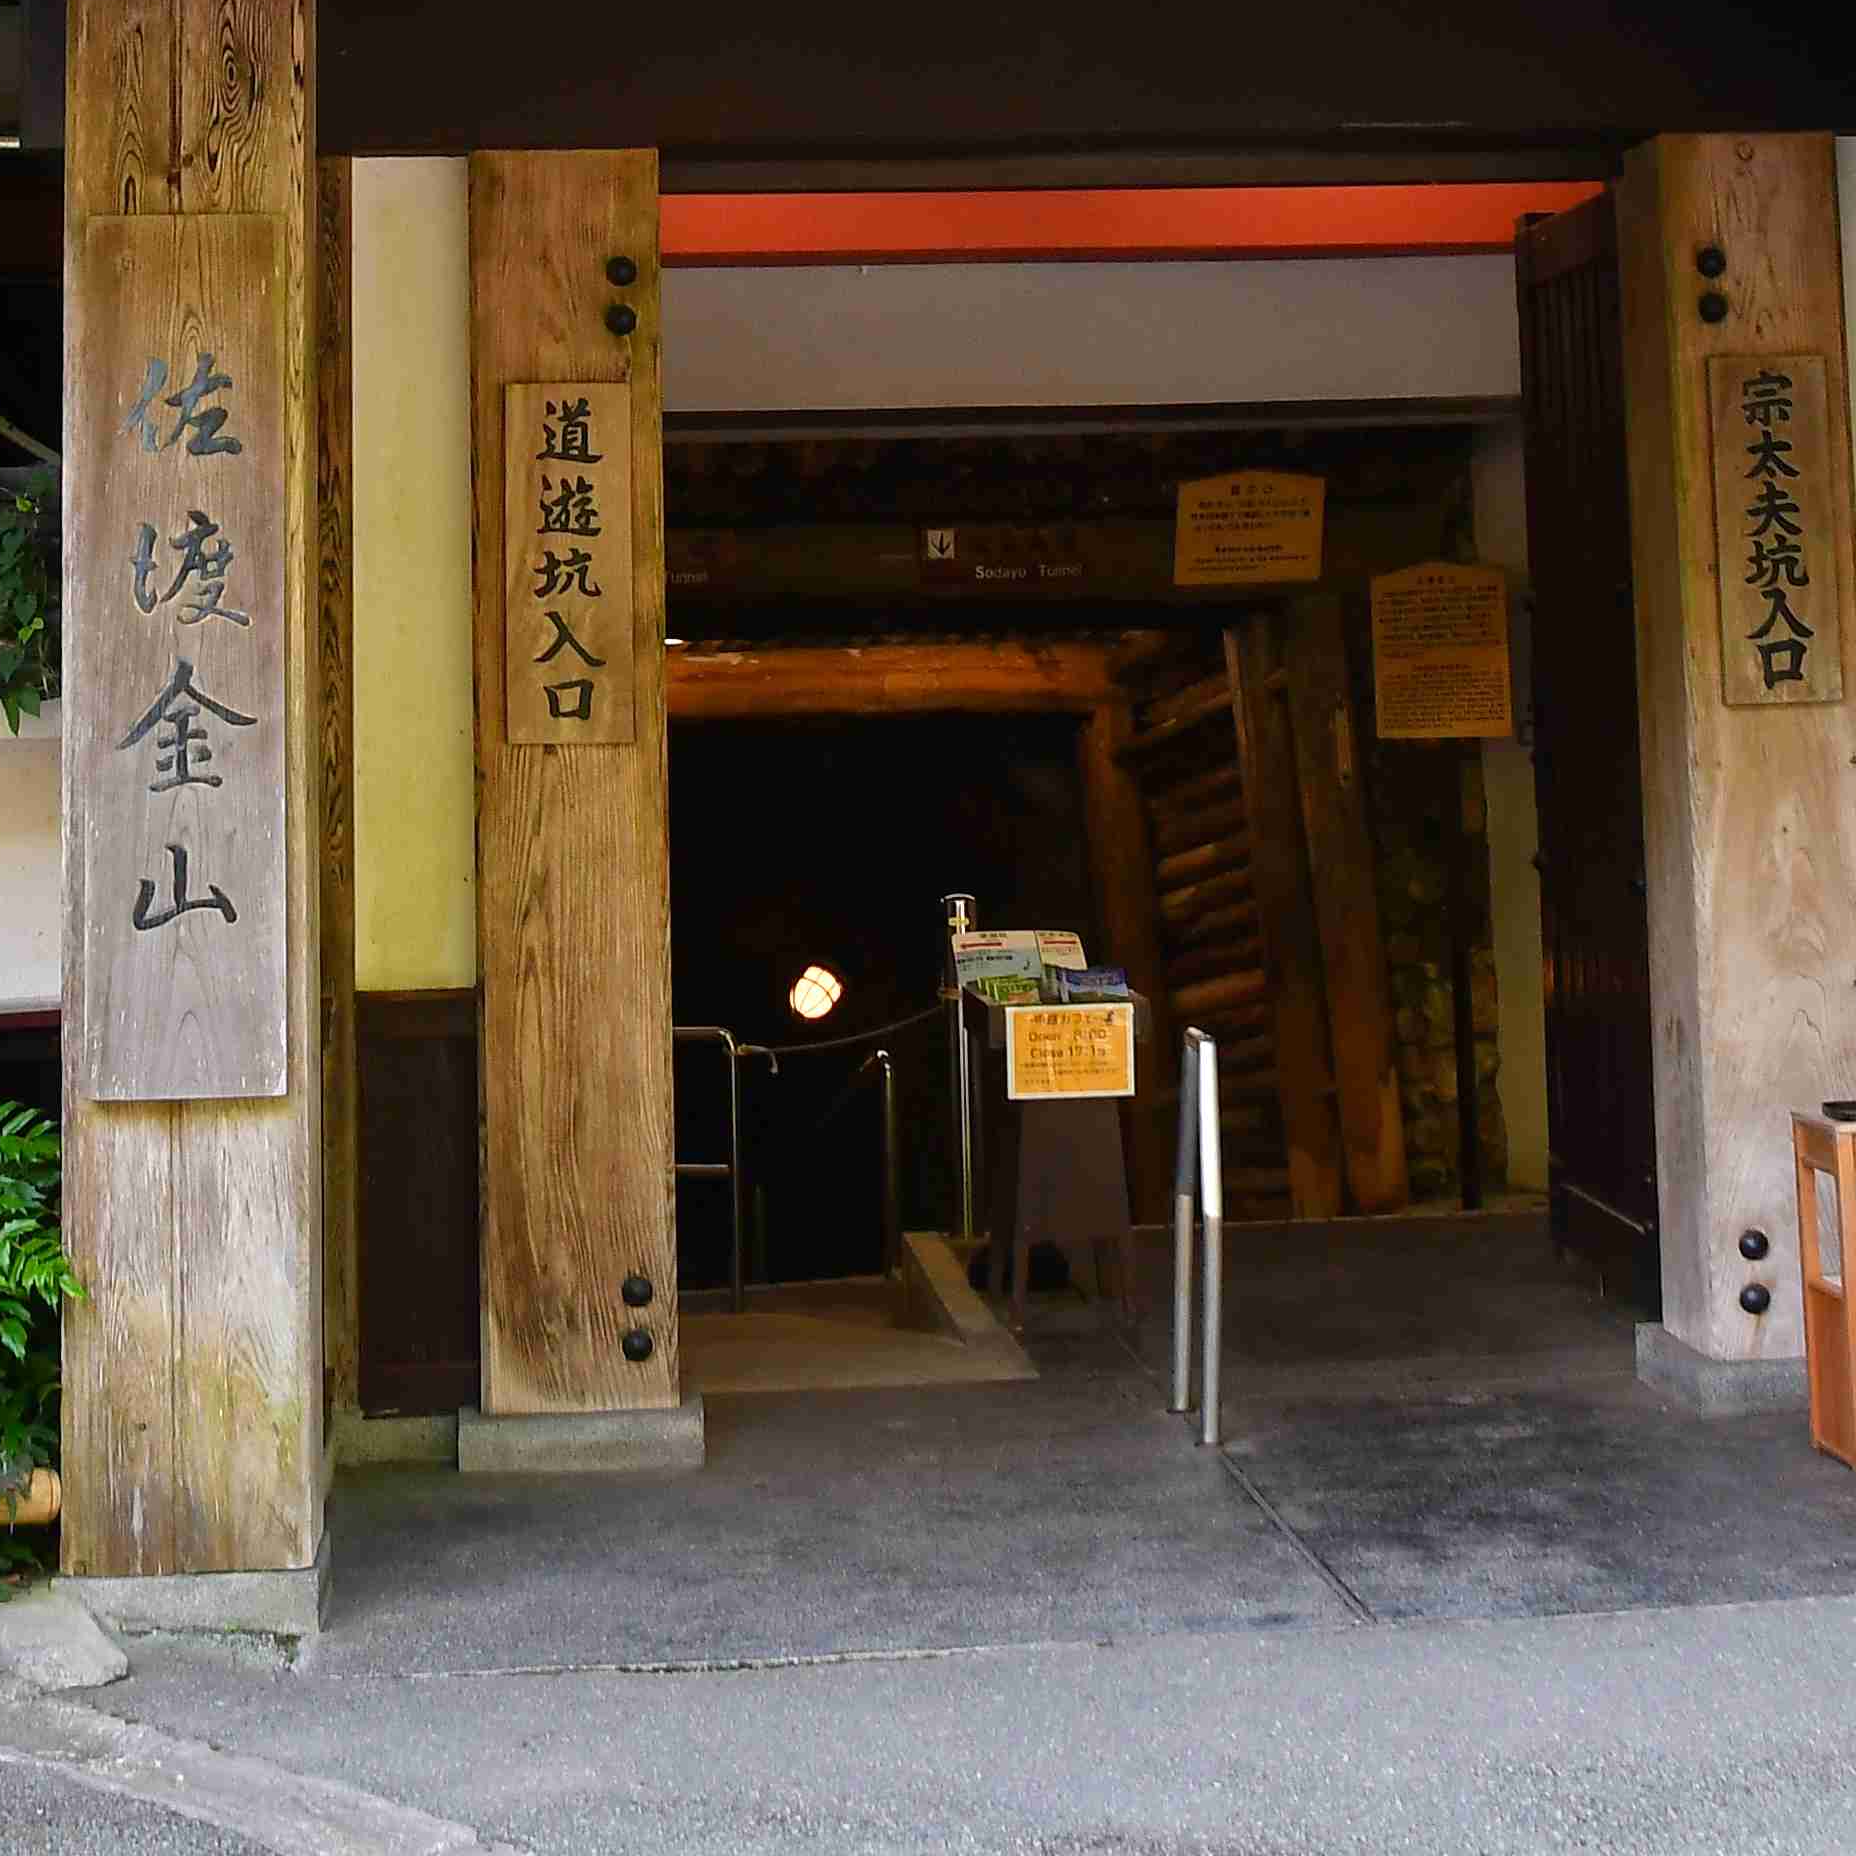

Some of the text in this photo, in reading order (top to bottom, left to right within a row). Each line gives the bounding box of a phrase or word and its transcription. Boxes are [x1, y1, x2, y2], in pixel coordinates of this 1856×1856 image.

[115, 352, 259, 932] 佐渡金山
[532, 397, 607, 722] 道遊坑入口
[1741, 370, 1816, 690] 宗太夫坑入口
